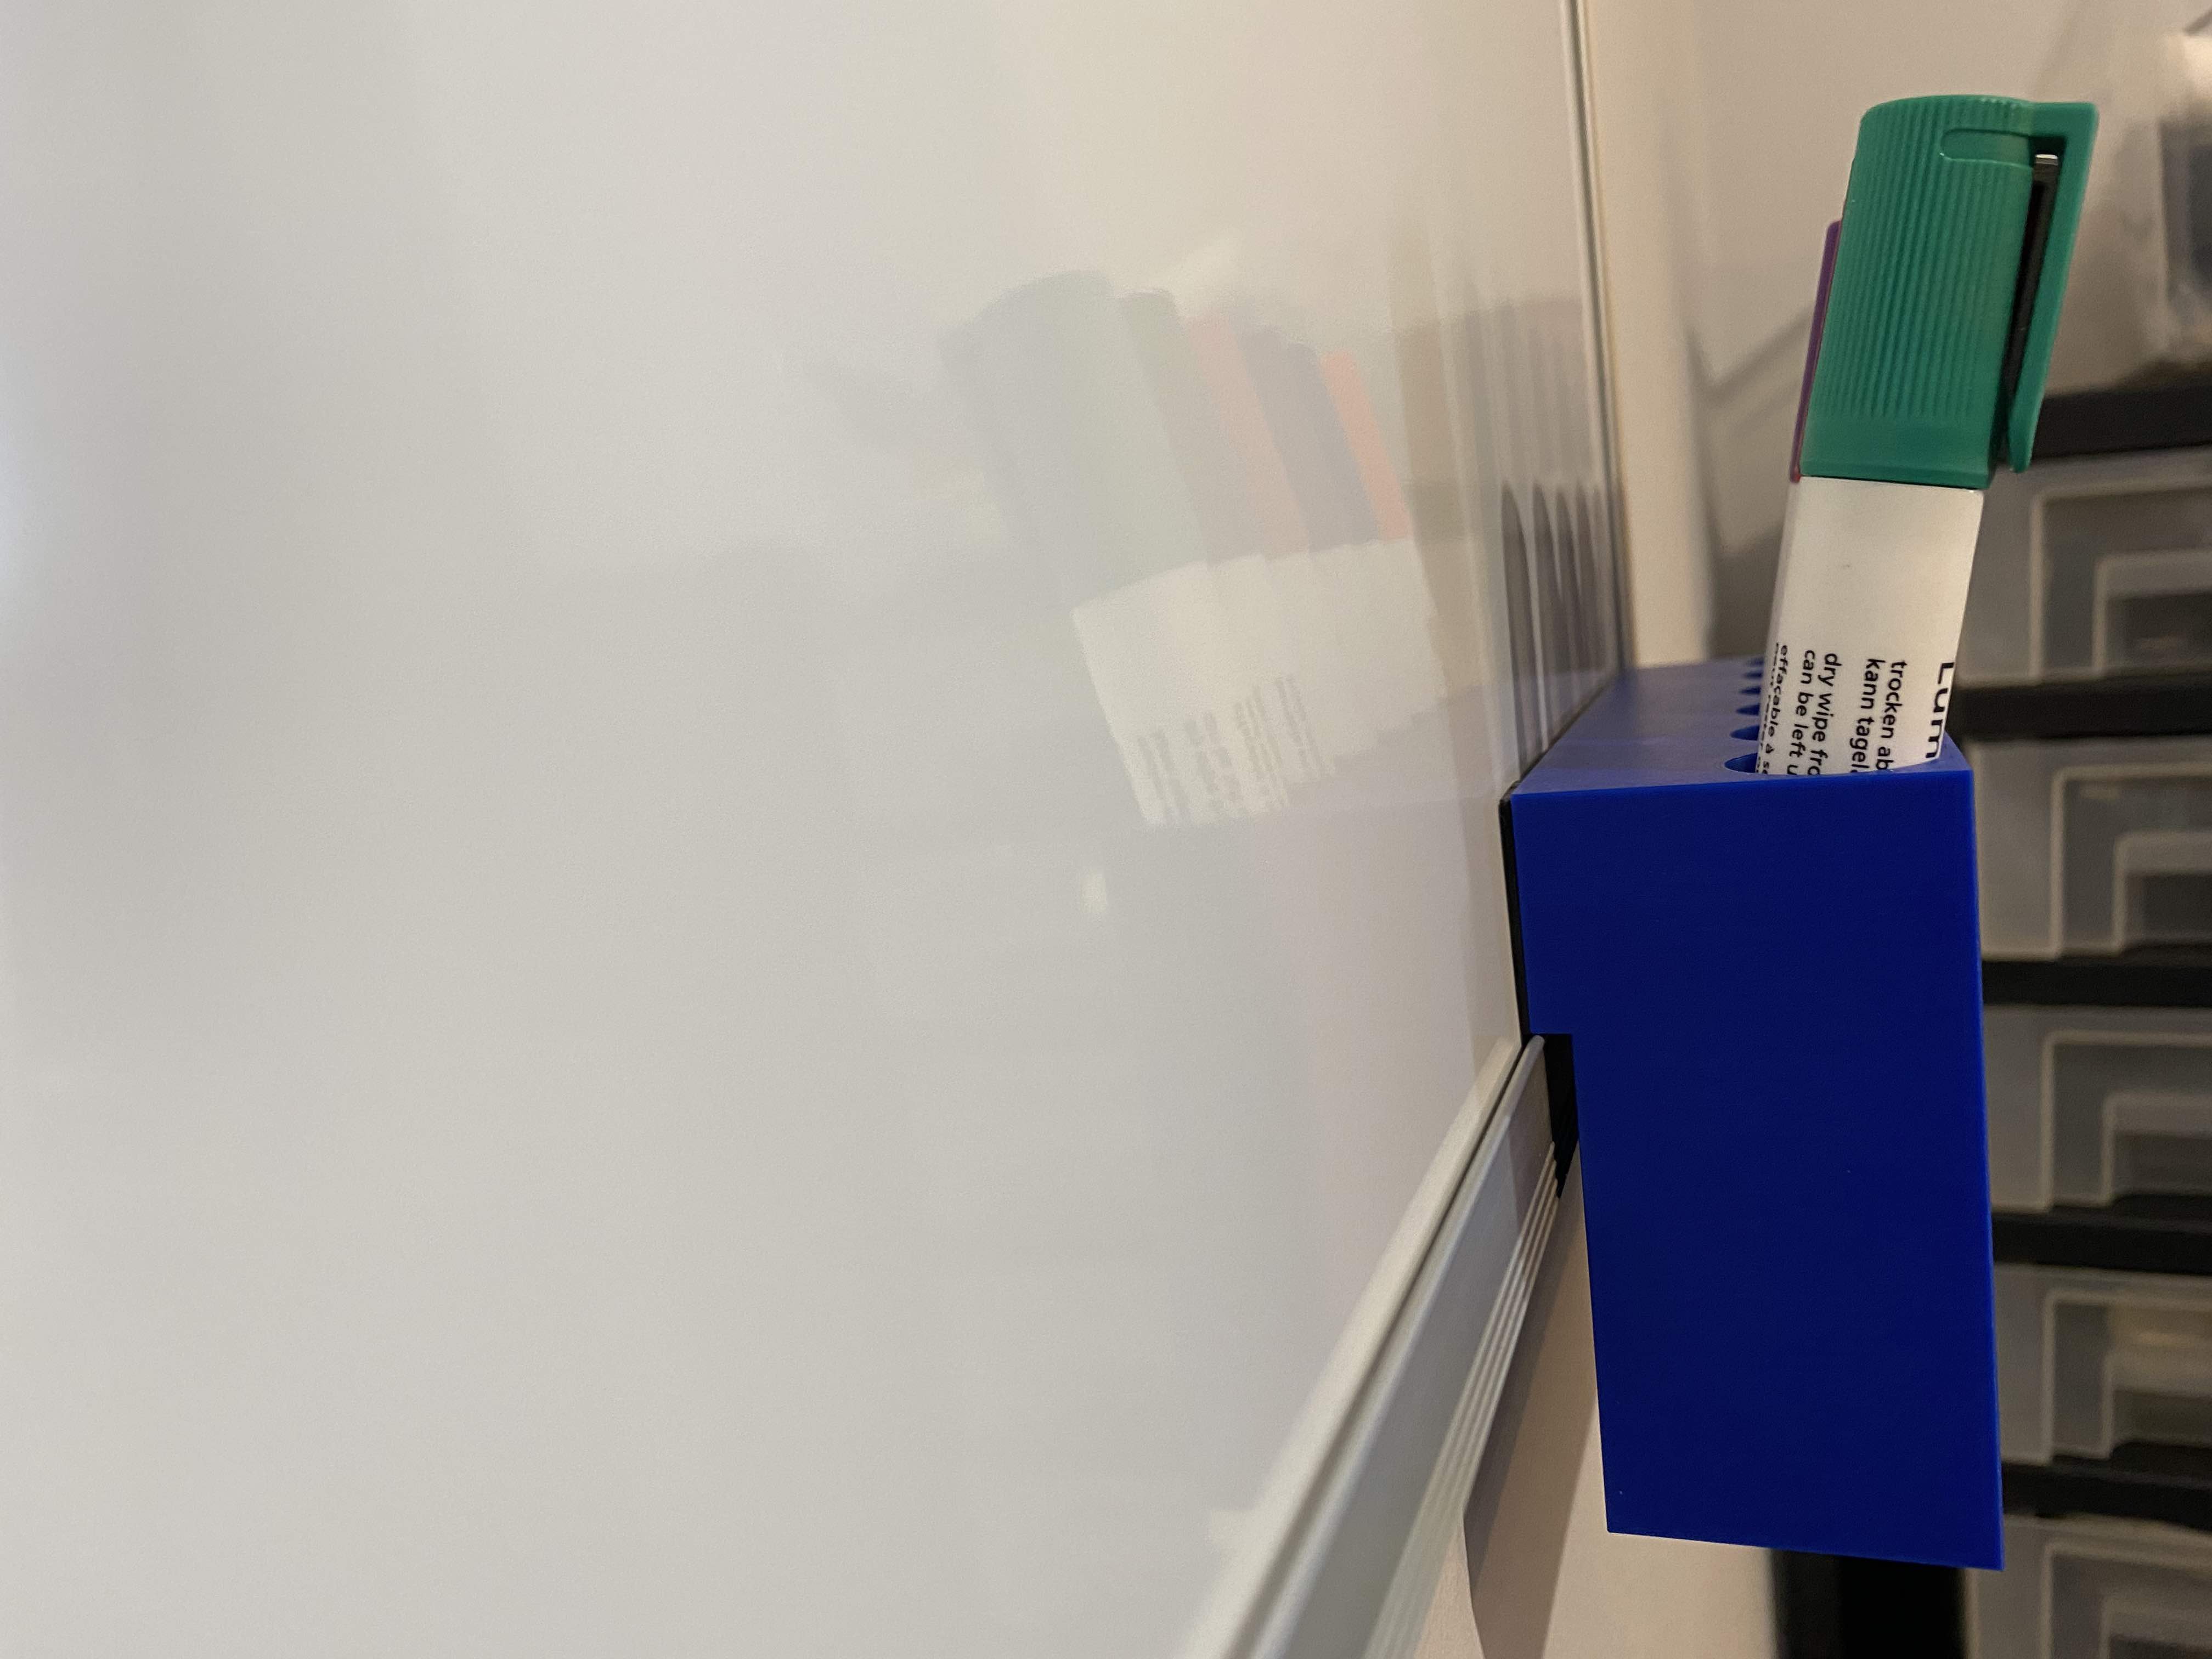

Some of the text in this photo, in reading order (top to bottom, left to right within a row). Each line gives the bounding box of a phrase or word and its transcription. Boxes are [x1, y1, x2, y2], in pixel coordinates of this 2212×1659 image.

[1796, 692, 1814, 716] be
[1800, 650, 1815, 684] can
[1807, 653, 1842, 775] dry wipe fro
[1926, 662, 1954, 758] Lum
[1789, 724, 1809, 758] left
[1849, 659, 1886, 773] kann tagel
[1876, 661, 1908, 770] trocken ab
